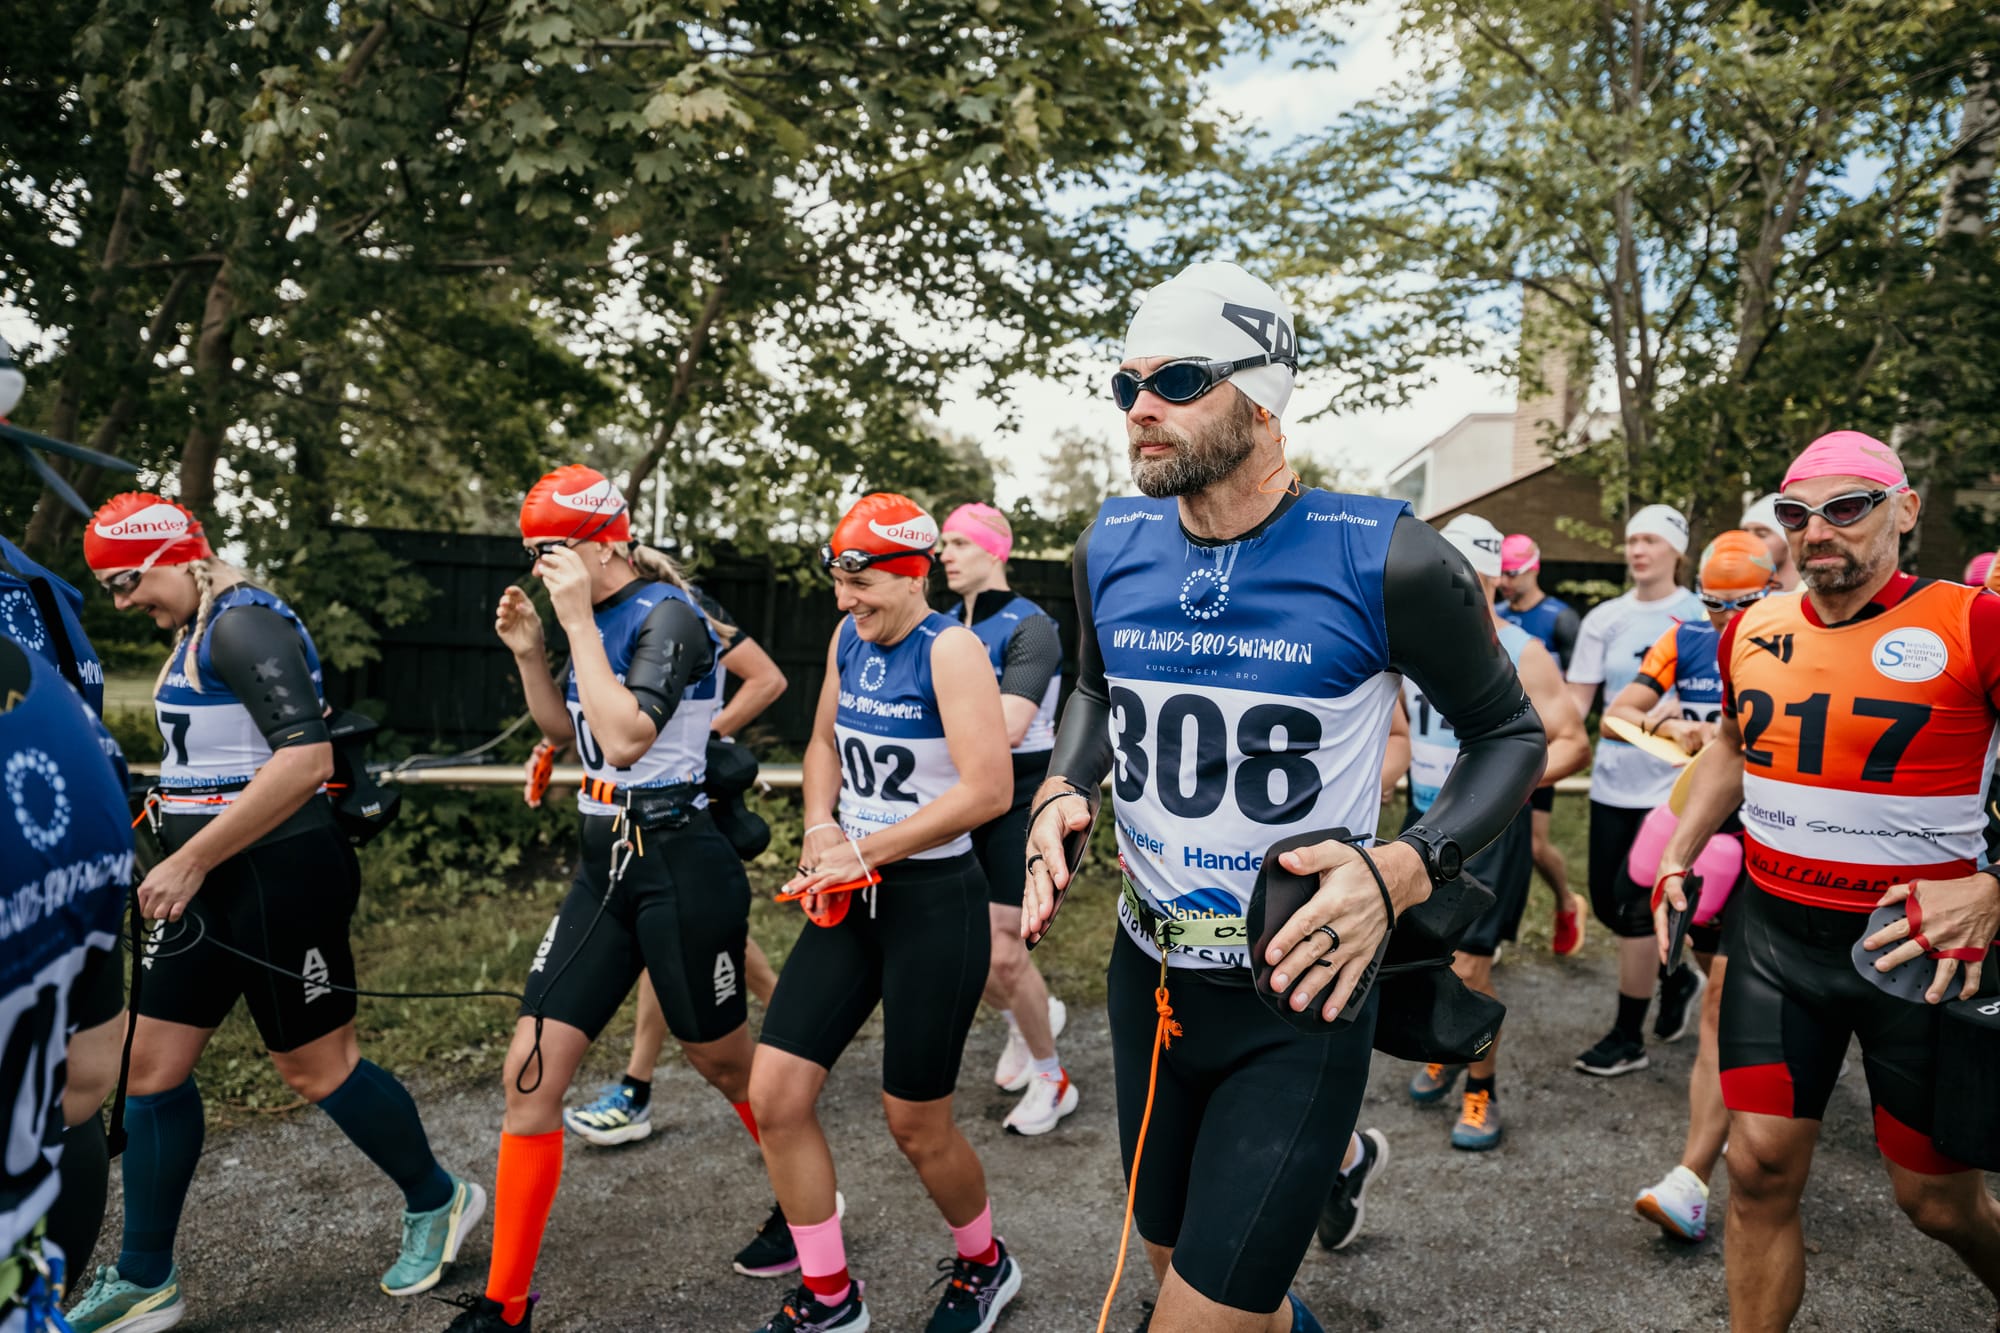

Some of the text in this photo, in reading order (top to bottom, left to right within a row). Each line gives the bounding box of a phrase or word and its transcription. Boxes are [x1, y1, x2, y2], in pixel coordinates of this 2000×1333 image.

[1227, 635, 1312, 665] SWIMRUN
[1235, 671, 1258, 681] BRO
[836, 731, 919, 804] 02
[1110, 686, 1323, 826] 308
[1737, 688, 1933, 784] 217
